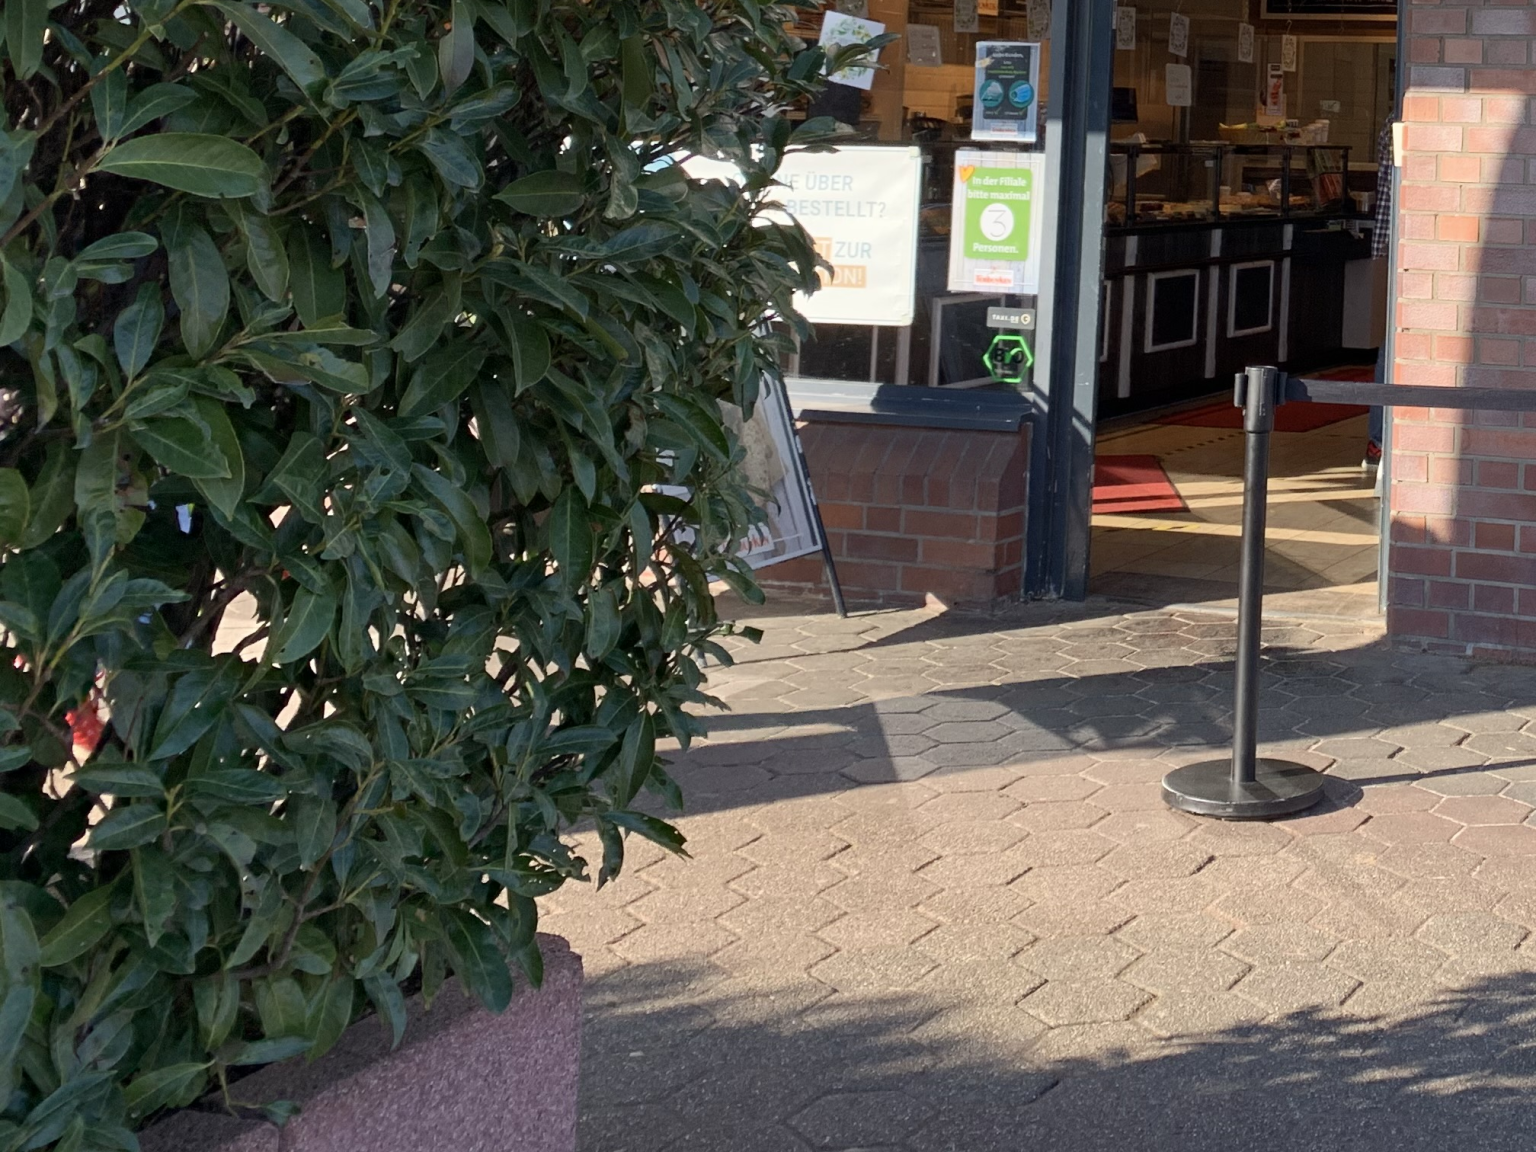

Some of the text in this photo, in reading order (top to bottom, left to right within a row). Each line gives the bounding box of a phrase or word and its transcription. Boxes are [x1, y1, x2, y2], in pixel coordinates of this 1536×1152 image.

[805, 170, 854, 192] ÜBER
[972, 176, 1027, 187] In der Filiale
[967, 189, 1031, 201] bitte maximal
[786, 199, 886, 218] BESTELLT?
[988, 209, 1007, 238] 3
[834, 241, 872, 259] ZUR
[973, 242, 1019, 254] Personen.
